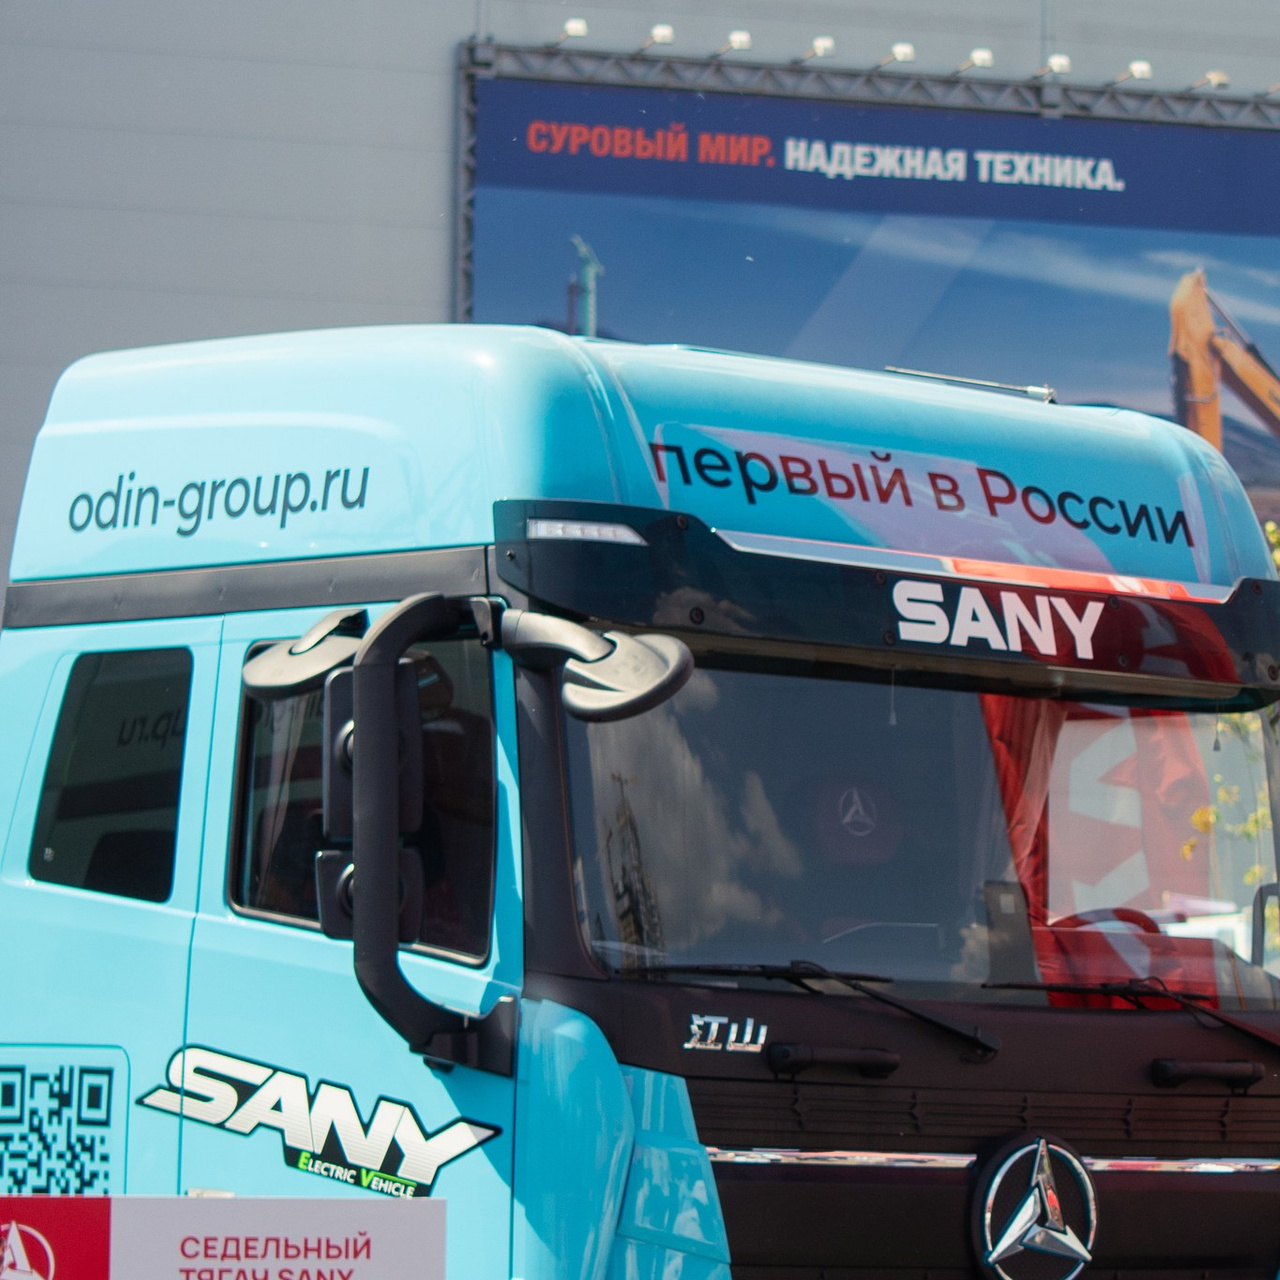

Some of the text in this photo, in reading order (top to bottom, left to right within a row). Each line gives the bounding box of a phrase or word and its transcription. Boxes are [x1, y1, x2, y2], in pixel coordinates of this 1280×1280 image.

[527, 119, 1126, 193] СУРОВЫЙ МИР. НАДЕЖНАЯ ТЕХНИКА.
[68, 466, 371, 538] odin-group.ru
[647, 440, 1196, 549] первый в России
[891, 579, 1105, 661] SANY
[139, 1044, 501, 1187] SANY
[179, 1231, 372, 1261] СЕДЕЛЬНЫЙ
